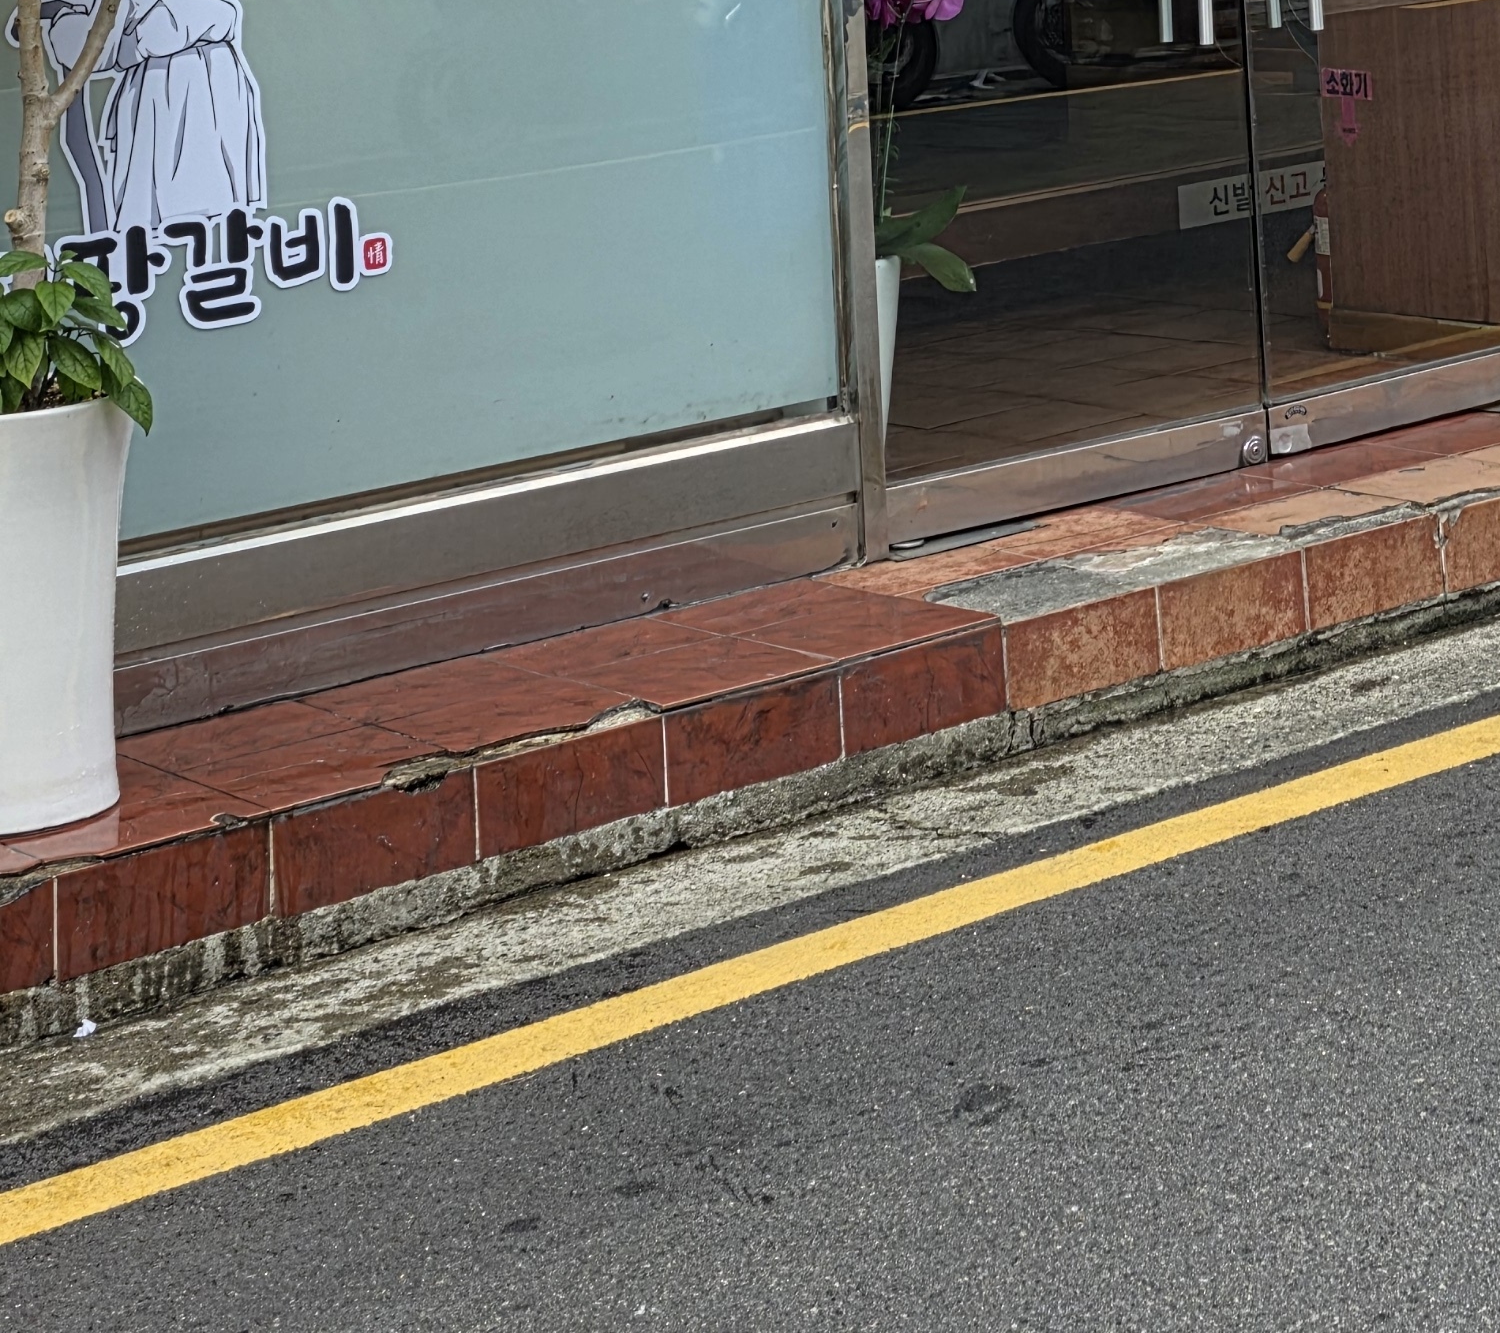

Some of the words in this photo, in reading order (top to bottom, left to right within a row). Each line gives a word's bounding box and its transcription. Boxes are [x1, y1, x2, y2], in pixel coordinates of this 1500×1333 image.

[1326, 70, 1368, 99] 소화기
[1265, 171, 1311, 206] 신고
[46, 204, 356, 341] 팡갈비
